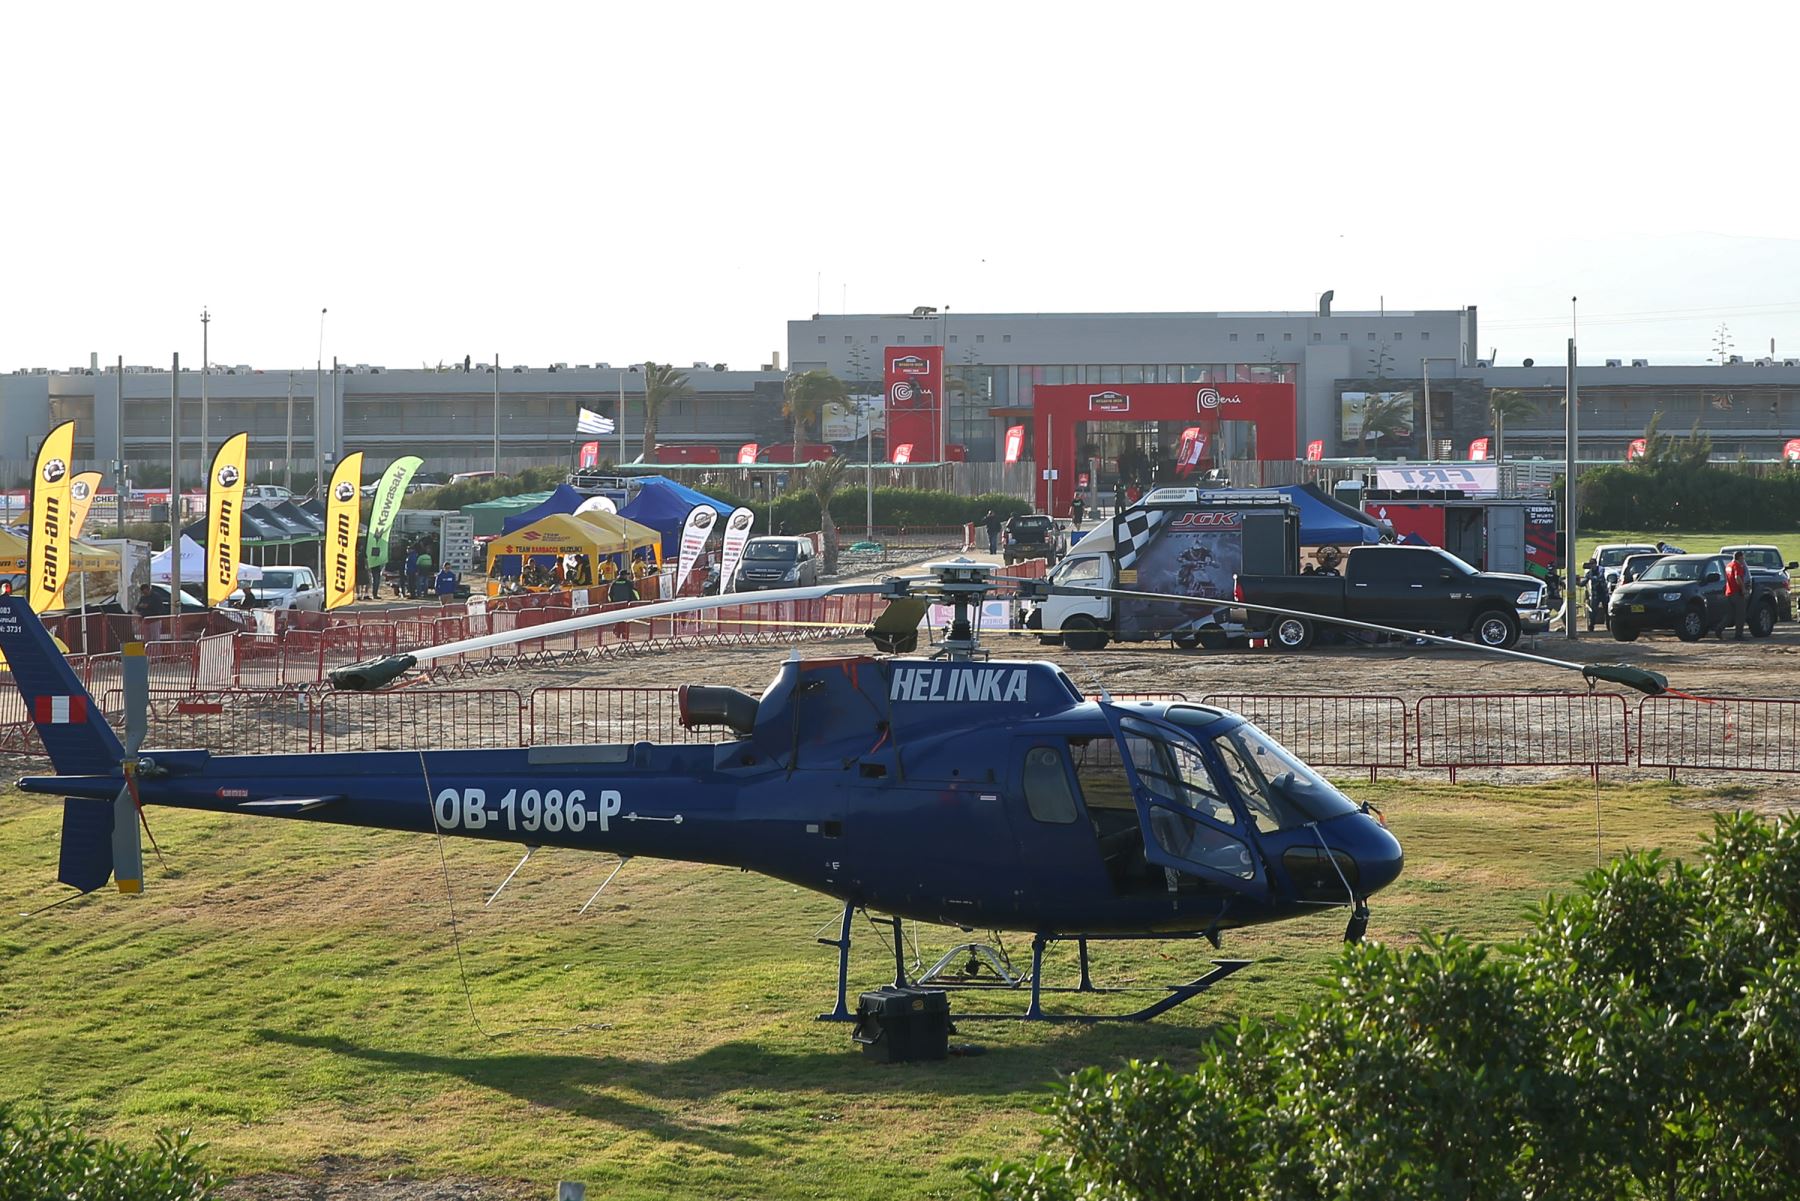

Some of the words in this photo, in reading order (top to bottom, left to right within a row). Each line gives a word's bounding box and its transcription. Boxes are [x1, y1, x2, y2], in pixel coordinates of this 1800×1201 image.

[377, 465, 407, 526] Kawasaki
[1171, 512, 1238, 526] JGK
[43, 496, 59, 593] can-am
[219, 499, 233, 586] can-am
[335, 513, 350, 593] can-am
[890, 668, 1028, 702] HELINKA
[434, 788, 622, 832] OB-1986-P
